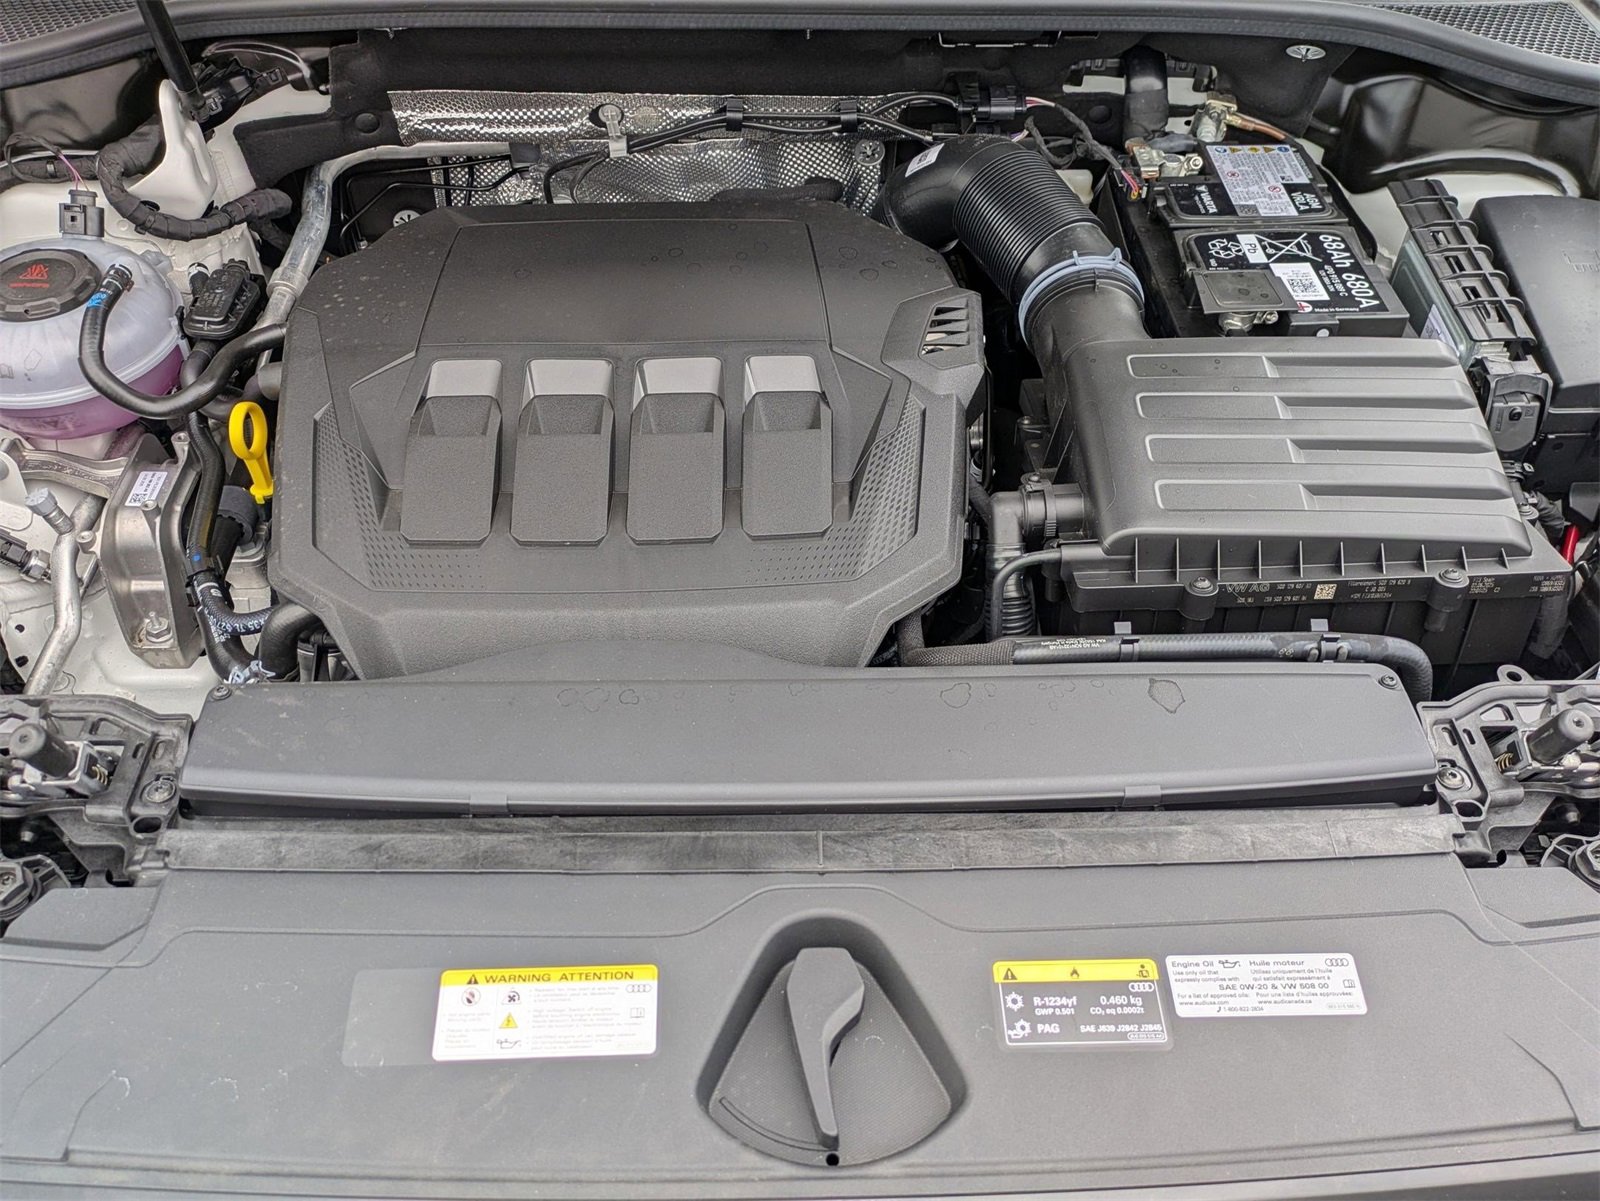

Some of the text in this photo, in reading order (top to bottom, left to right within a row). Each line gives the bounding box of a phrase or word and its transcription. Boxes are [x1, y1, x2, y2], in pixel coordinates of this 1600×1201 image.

[1200, 192, 1218, 214] VARTA
[1291, 192, 1310, 210] VRLA
[1303, 193, 1322, 208] AGM
[1244, 242, 1256, 254] Pb
[1318, 234, 1380, 308] 68Ah 680A
[1226, 583, 1270, 592] VW AG
[485, 971, 634, 983] WARNING ATTENTION
[1033, 995, 1142, 1007] R-1234yf 0.460 kg
[1037, 1024, 1060, 1033] PAG
